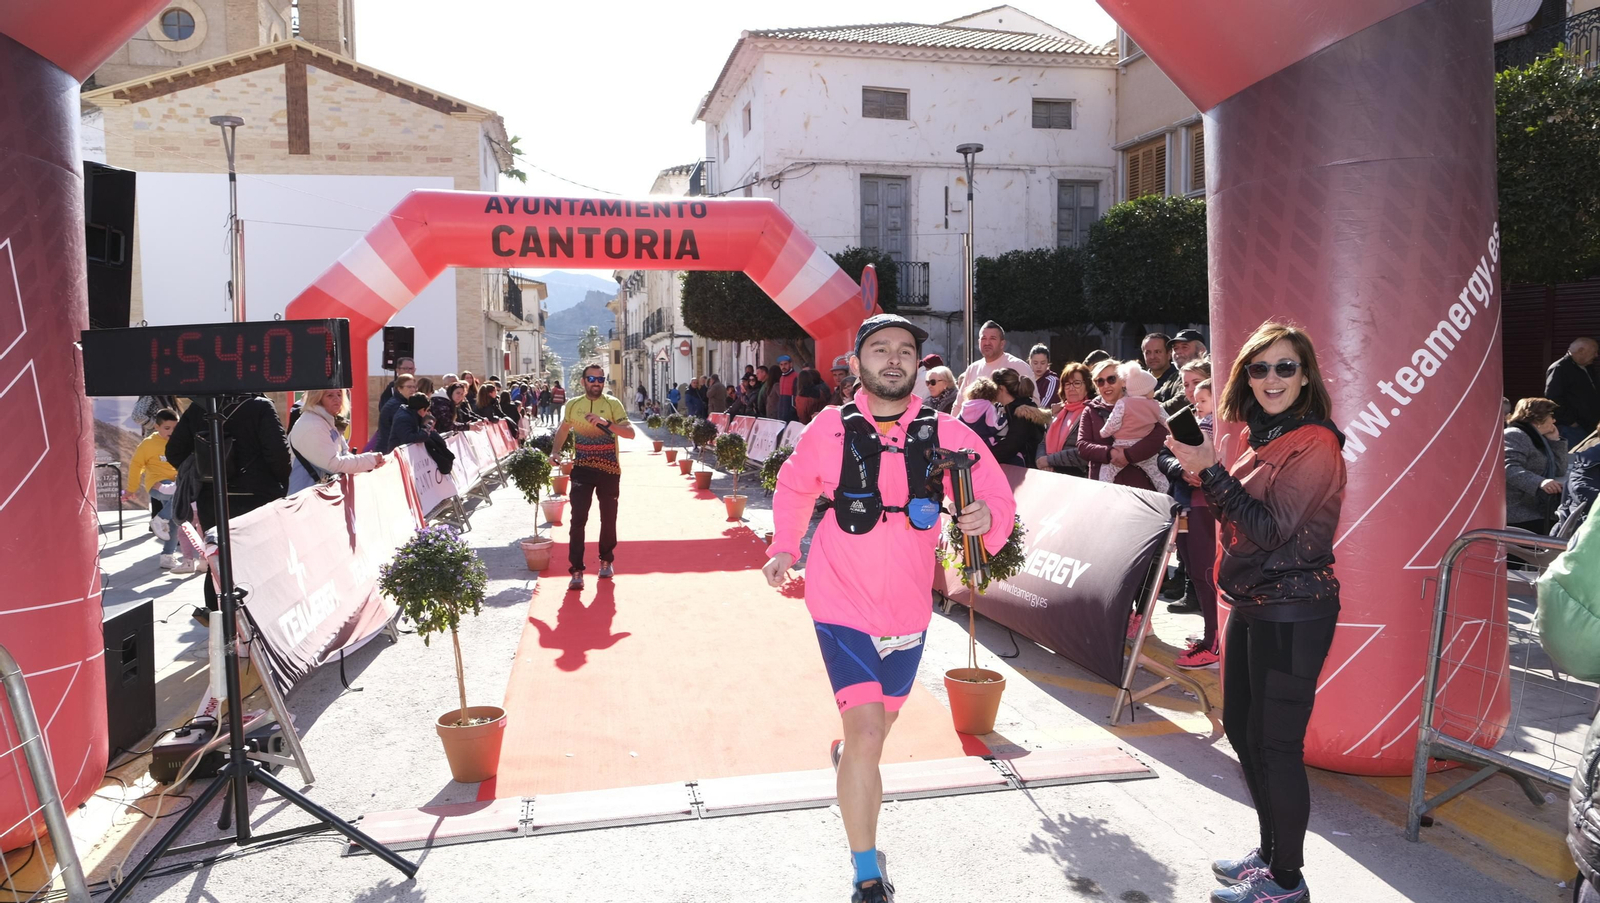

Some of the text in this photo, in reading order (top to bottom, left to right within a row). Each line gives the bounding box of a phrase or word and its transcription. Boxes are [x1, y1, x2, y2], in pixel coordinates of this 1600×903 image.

[484, 196, 707, 219] AYUNTAMIENTO
[491, 224, 700, 261] CANTORIA
[151, 326, 332, 384] 1:54:07
[1341, 221, 1500, 463] ww.teamergy.es
[1018, 546, 1092, 589] MERGY
[999, 580, 1048, 609] www.teamergy.es
